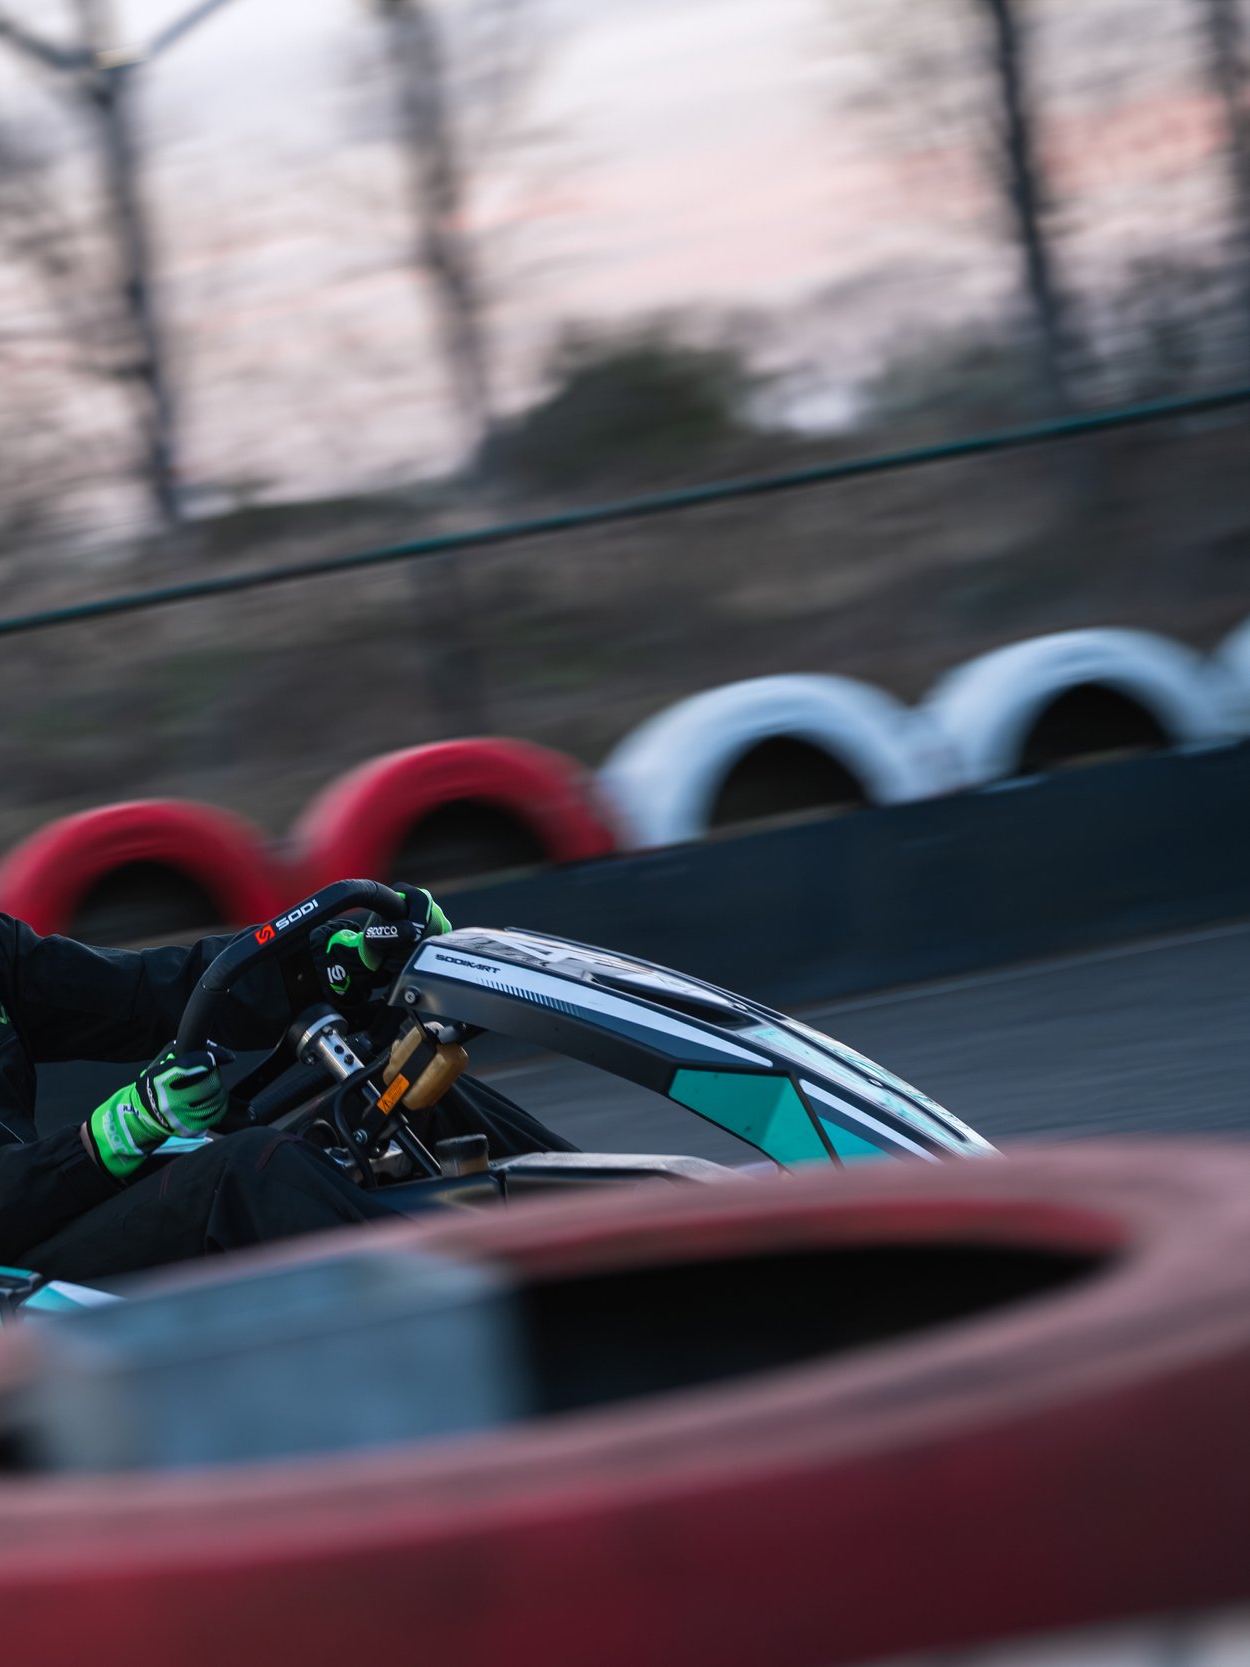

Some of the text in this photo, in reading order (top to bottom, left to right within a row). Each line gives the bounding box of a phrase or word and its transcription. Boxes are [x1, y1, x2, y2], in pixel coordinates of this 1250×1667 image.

[275, 899, 319, 931] SODI
[366, 925, 398, 938] sparco
[436, 954, 500, 974] SODIKART
